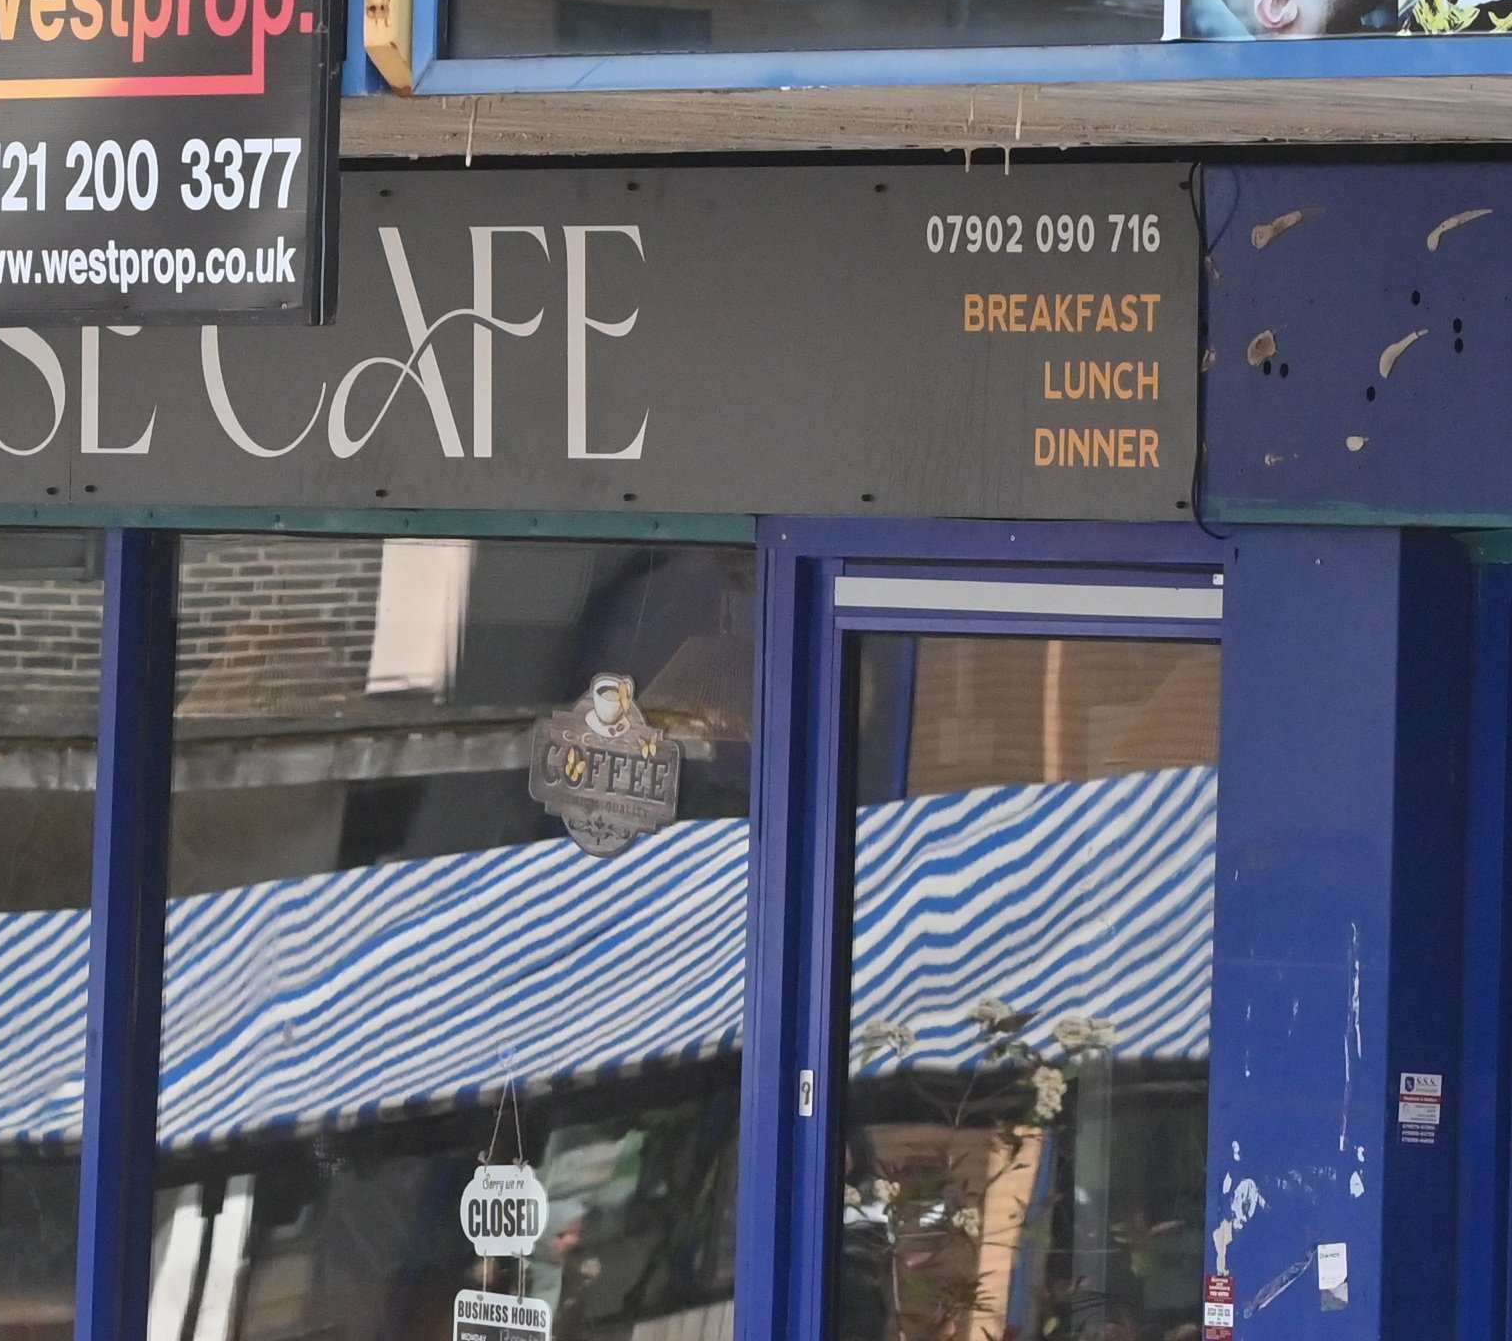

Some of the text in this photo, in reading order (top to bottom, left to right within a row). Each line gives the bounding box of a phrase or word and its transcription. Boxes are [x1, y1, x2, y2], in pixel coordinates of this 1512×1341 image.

[65, 138, 159, 211] 200
[181, 137, 302, 210] 3377
[926, 214, 1161, 253] 07902 090 716
[964, 294, 1161, 332] BREAKFAST
[1044, 361, 1159, 400] LUNCH
[1034, 428, 1160, 467] DINNER
[543, 743, 670, 805] COFFEE
[468, 1198, 539, 1237] CLOSED
[457, 1300, 547, 1329] BUSINESS HOURS
